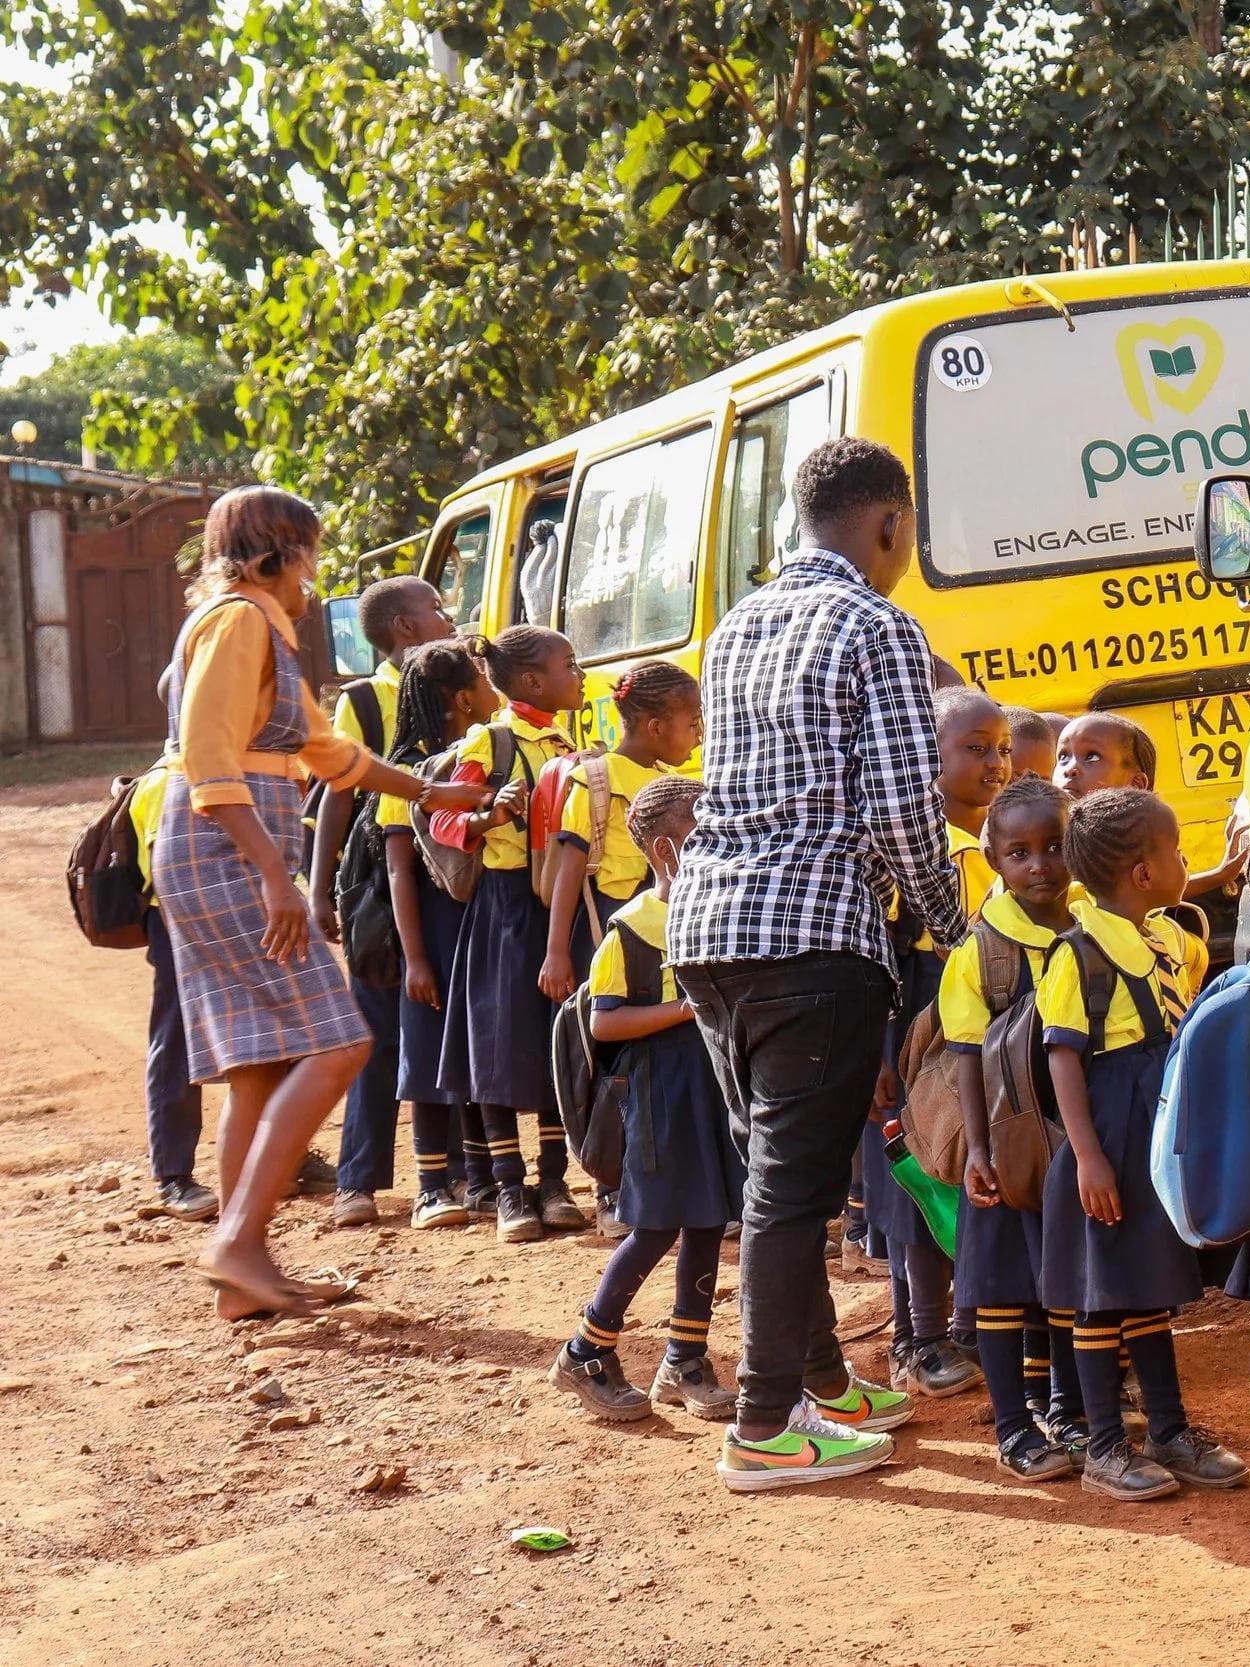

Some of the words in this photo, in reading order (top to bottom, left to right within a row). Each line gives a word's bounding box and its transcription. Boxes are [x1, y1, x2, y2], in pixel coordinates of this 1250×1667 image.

[941, 346, 984, 377] 80
[956, 377, 979, 387] KPH
[994, 521, 1136, 558] ENGAGE.
[961, 620, 1250, 683] TEL:0112025117
